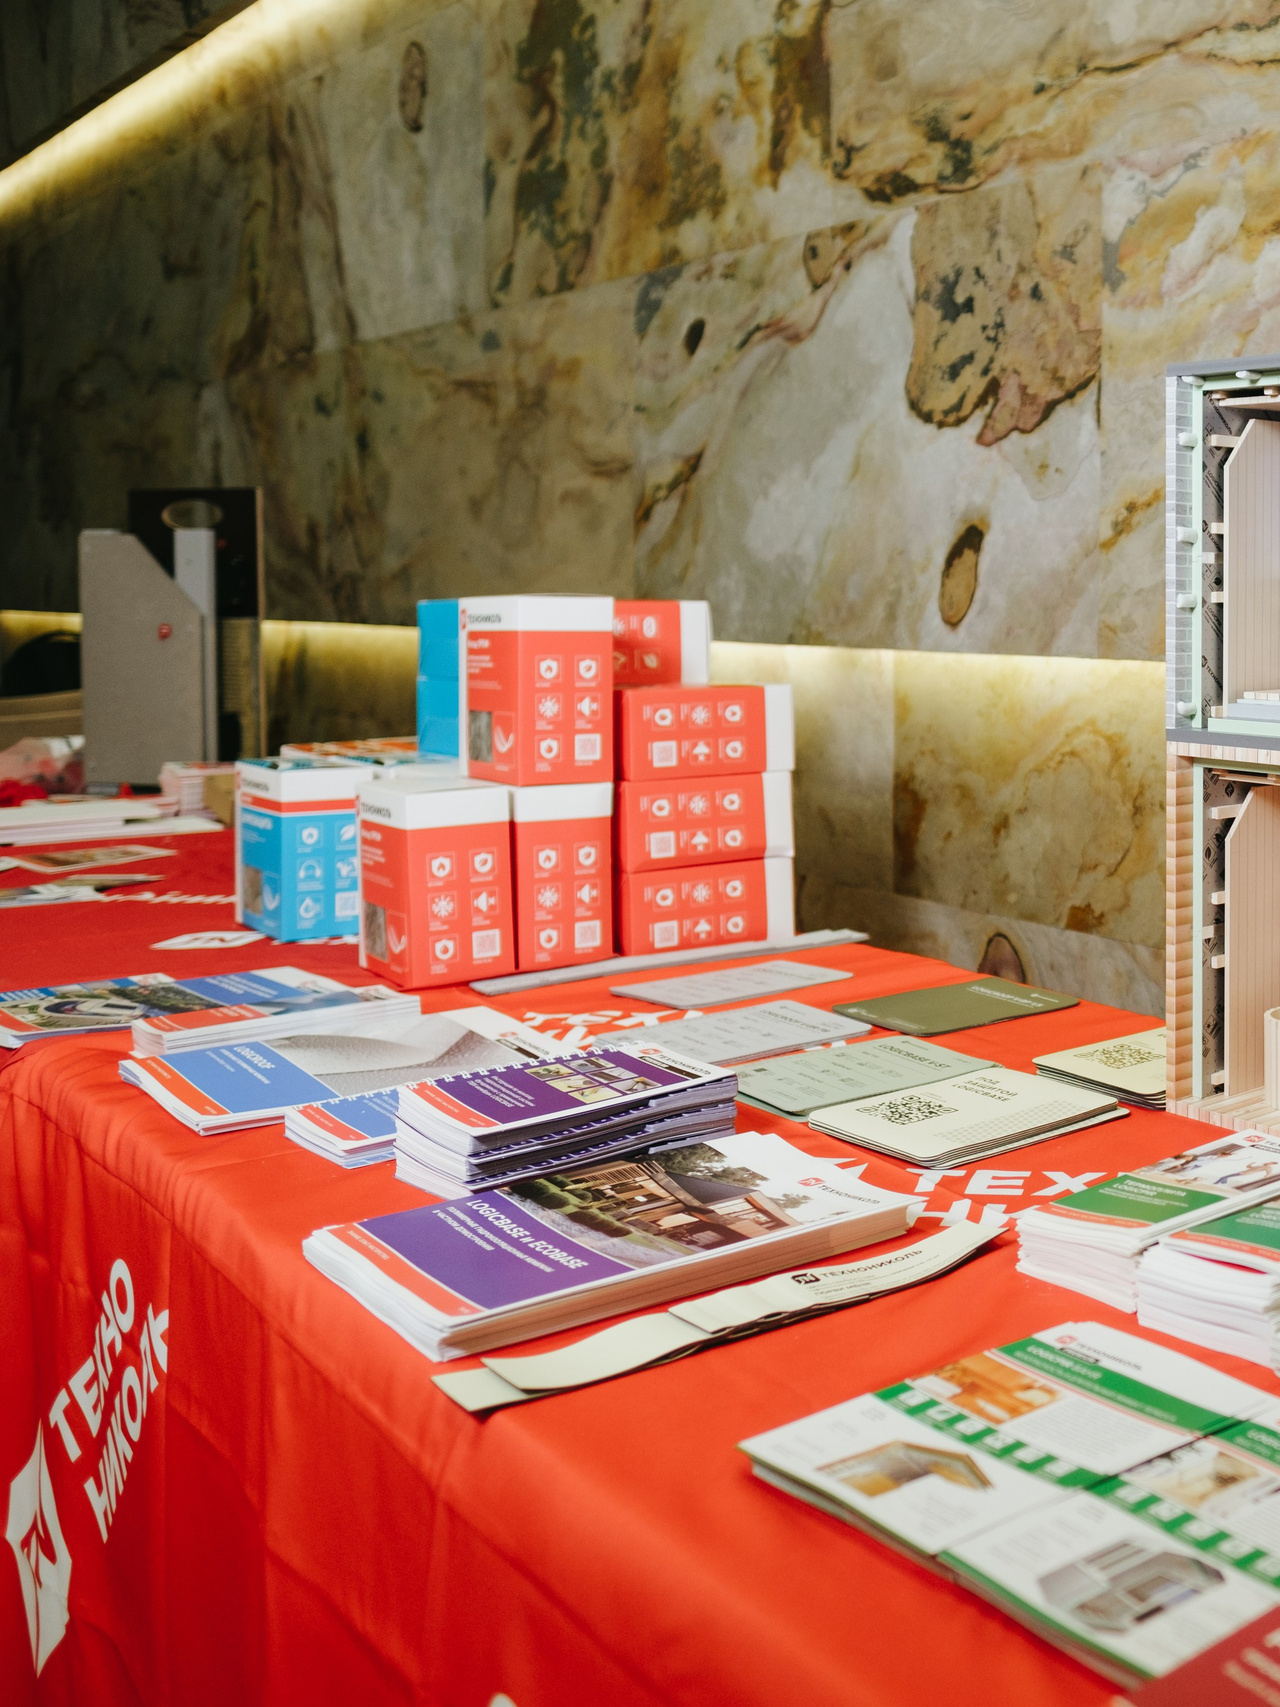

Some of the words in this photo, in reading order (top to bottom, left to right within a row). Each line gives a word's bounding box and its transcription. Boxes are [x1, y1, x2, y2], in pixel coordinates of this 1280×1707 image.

[975, 1076, 1000, 1085] ПОД
[818, 1183, 880, 1205] ТЕХНОНИКОЛЬ
[906, 1167, 1130, 1196] ТЕХ
[466, 1199, 530, 1239] LOGICBASE
[528, 1240, 589, 1270] ECOBASE
[818, 1249, 924, 1279] ТЕХНОНИКОЛЬ
[49, 1258, 135, 1463] ТЕХНО
